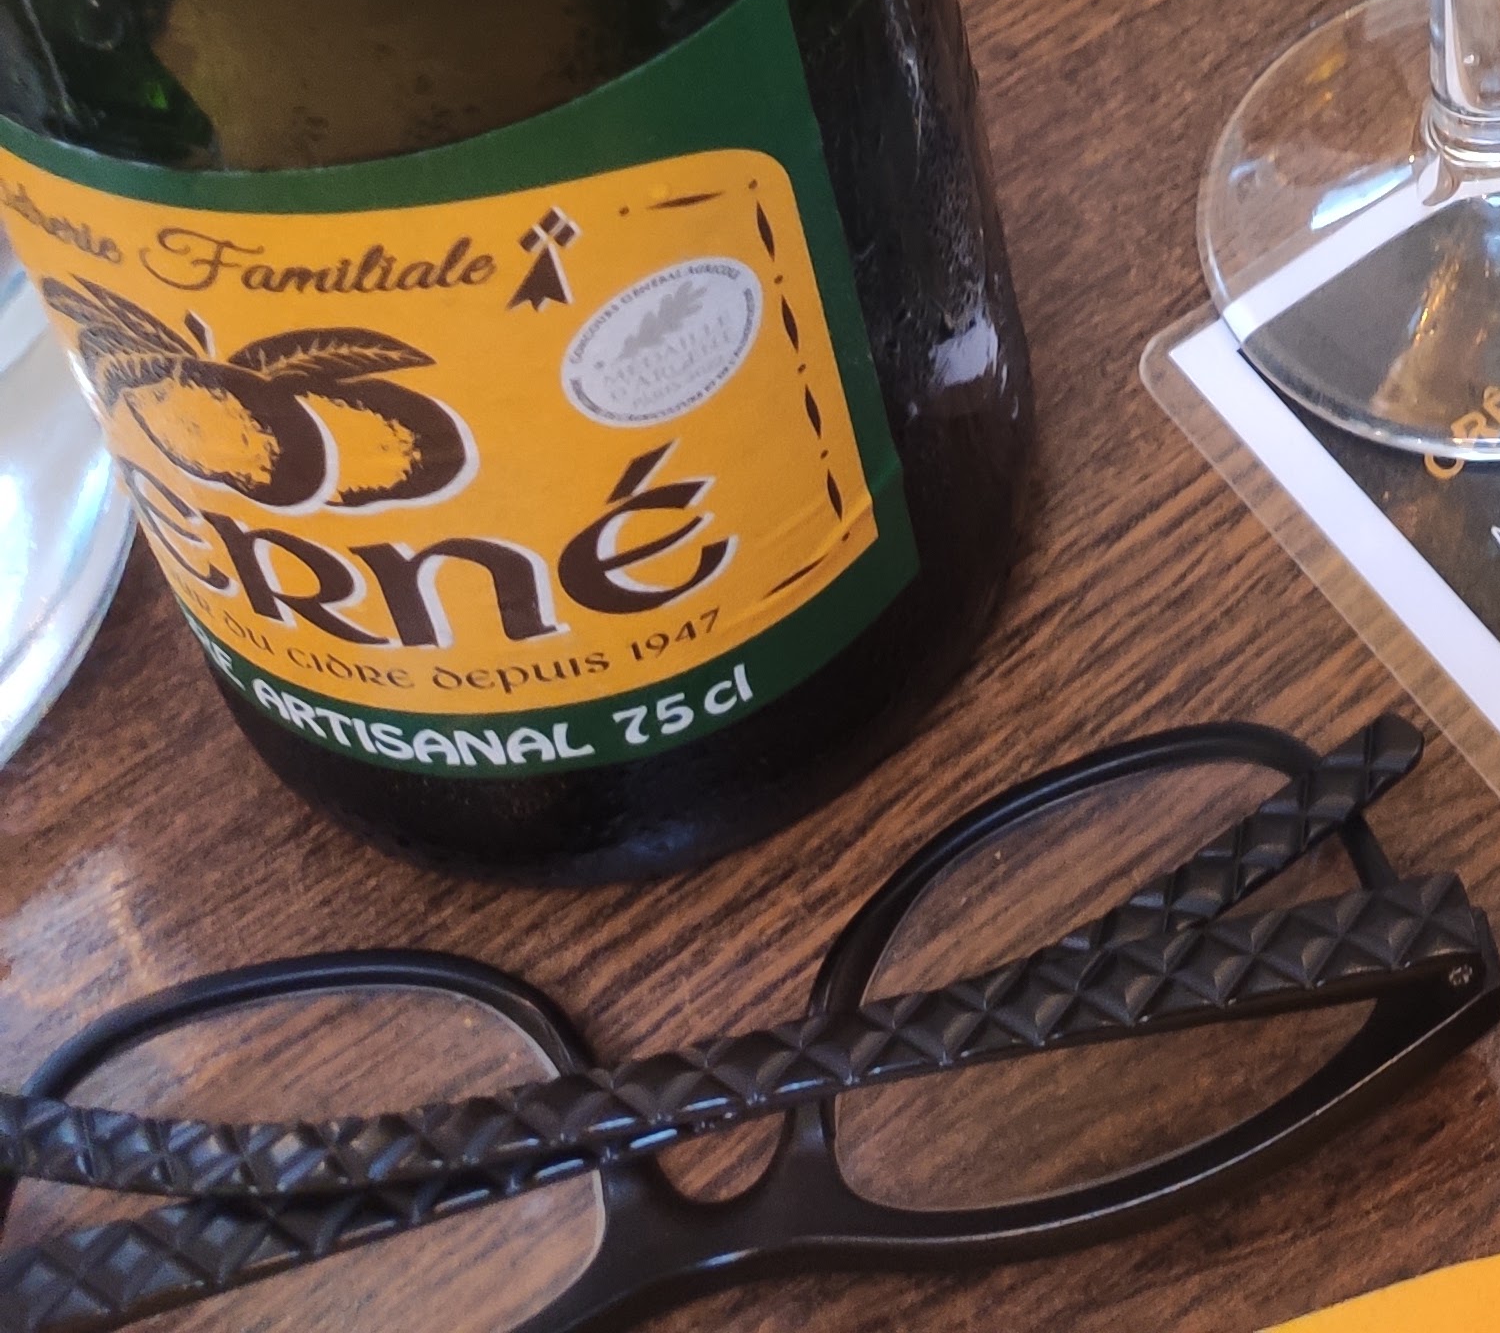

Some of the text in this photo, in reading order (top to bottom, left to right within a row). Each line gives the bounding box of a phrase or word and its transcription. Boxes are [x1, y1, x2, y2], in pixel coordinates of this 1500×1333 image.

[138, 227, 497, 294] Familiale
[431, 651, 611, 695] depuis
[629, 605, 721, 663] 1947
[252, 676, 596, 769] ARTISANAL
[611, 691, 695, 745] 75
